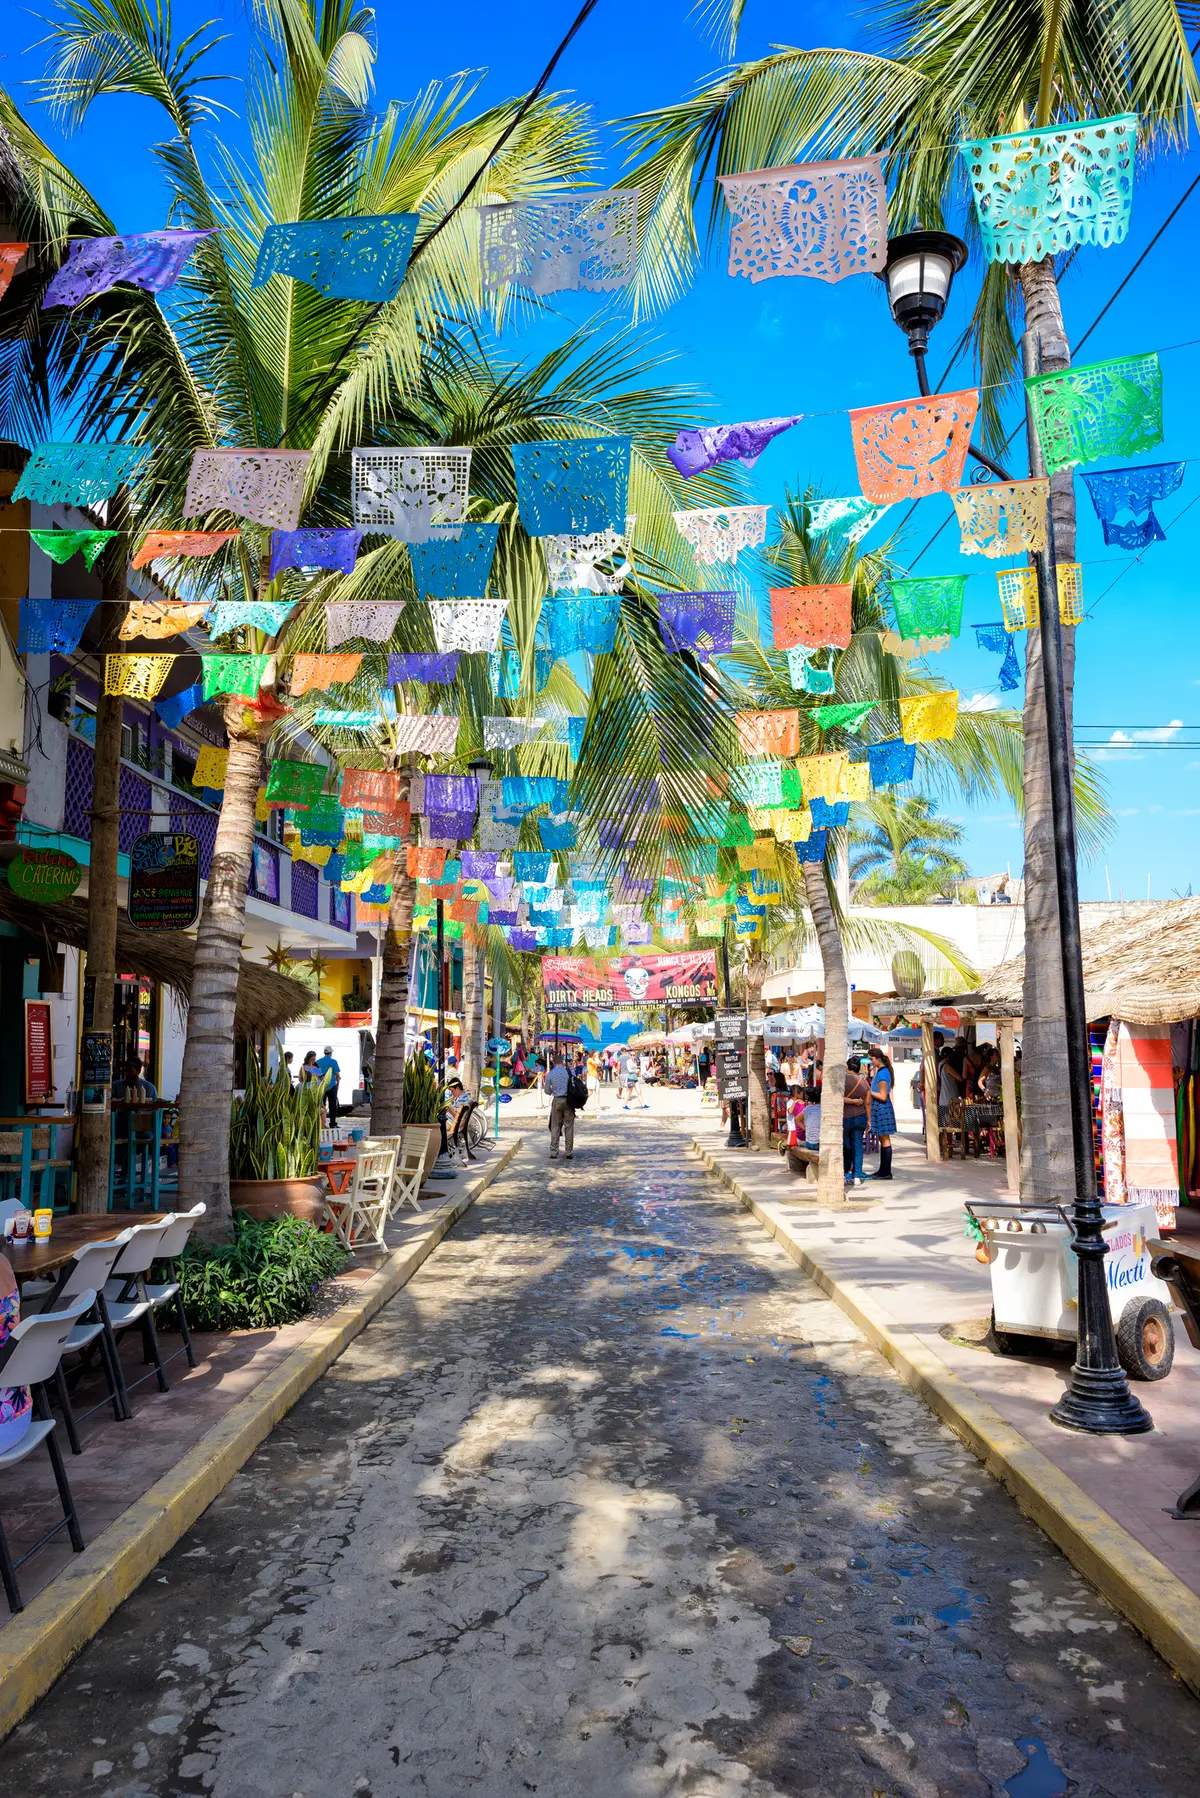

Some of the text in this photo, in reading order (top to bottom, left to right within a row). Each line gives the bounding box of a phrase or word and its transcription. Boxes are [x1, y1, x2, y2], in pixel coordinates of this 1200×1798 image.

[174, 835, 198, 857] Big
[549, 989, 614, 1003] DIRTY HEADS
[665, 984, 701, 998] KONGOS
